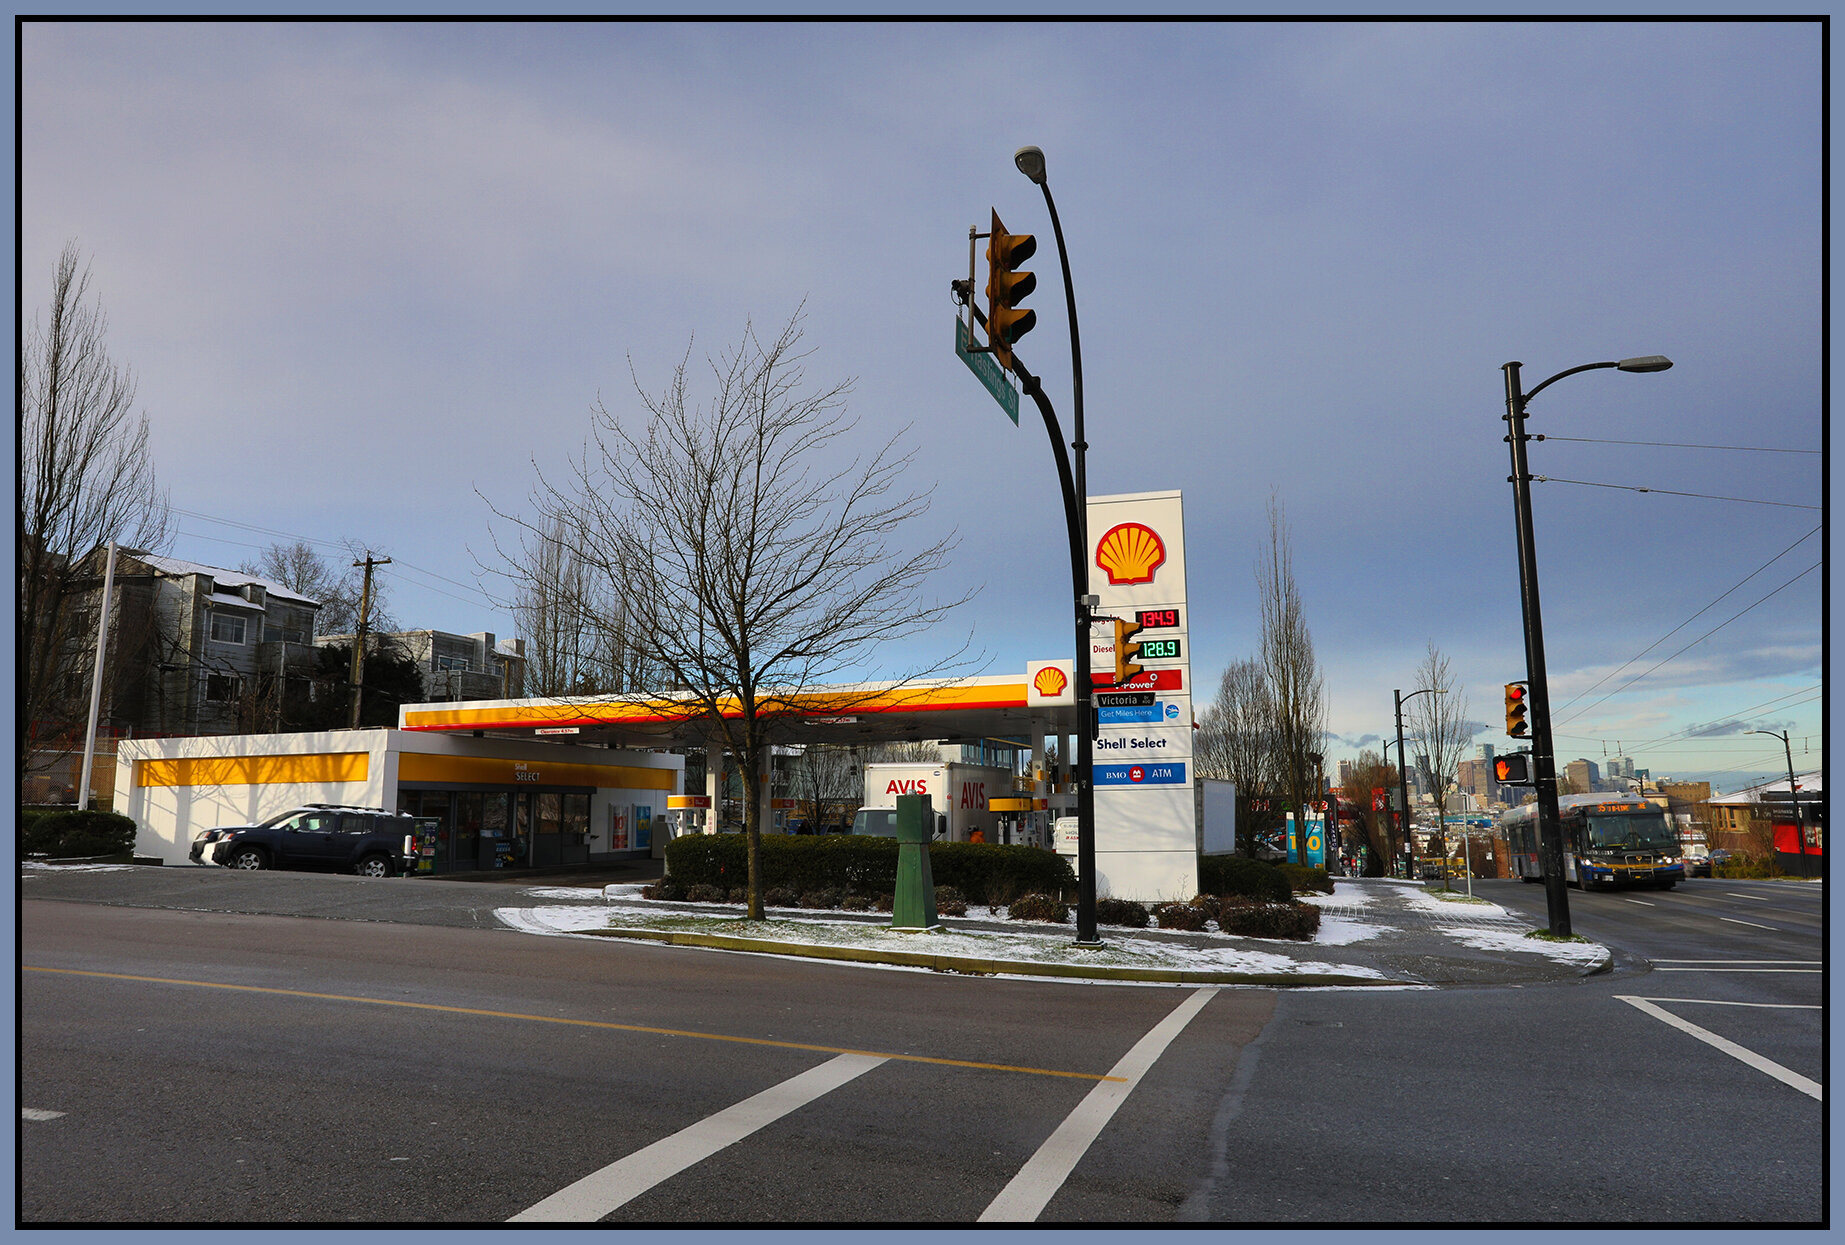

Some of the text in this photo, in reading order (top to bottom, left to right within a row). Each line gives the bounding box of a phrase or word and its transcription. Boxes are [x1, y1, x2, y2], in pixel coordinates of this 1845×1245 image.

[1008, 387, 1017, 414] St
[1142, 611, 1175, 627] 134.9
[1143, 641, 1176, 658] 128.9
[1101, 695, 1138, 705] Victoria
[1101, 709, 1153, 718] Get Miles Here
[1097, 737, 1167, 750] Shell Select
[515, 763, 528, 771] Shell
[1152, 769, 1172, 778] ATM
[516, 772, 540, 781] SELECT
[885, 779, 927, 795] AVIS
[961, 781, 985, 810] AVIS
